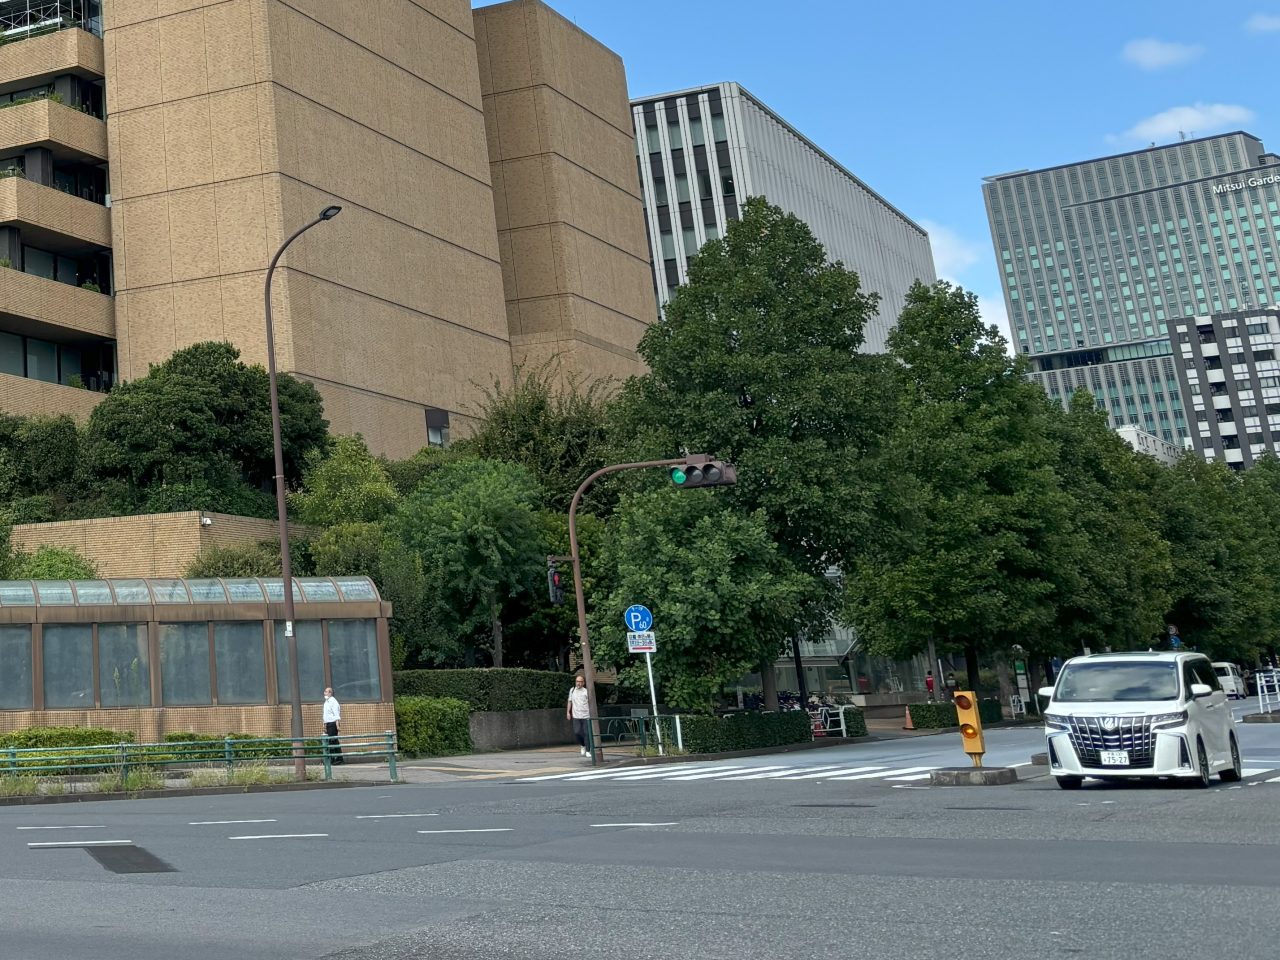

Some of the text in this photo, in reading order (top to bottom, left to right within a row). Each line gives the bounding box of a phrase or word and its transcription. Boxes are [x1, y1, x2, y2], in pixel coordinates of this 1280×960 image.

[1212, 174, 1280, 194] Mitsui Garde
[631, 613, 641, 629] P
